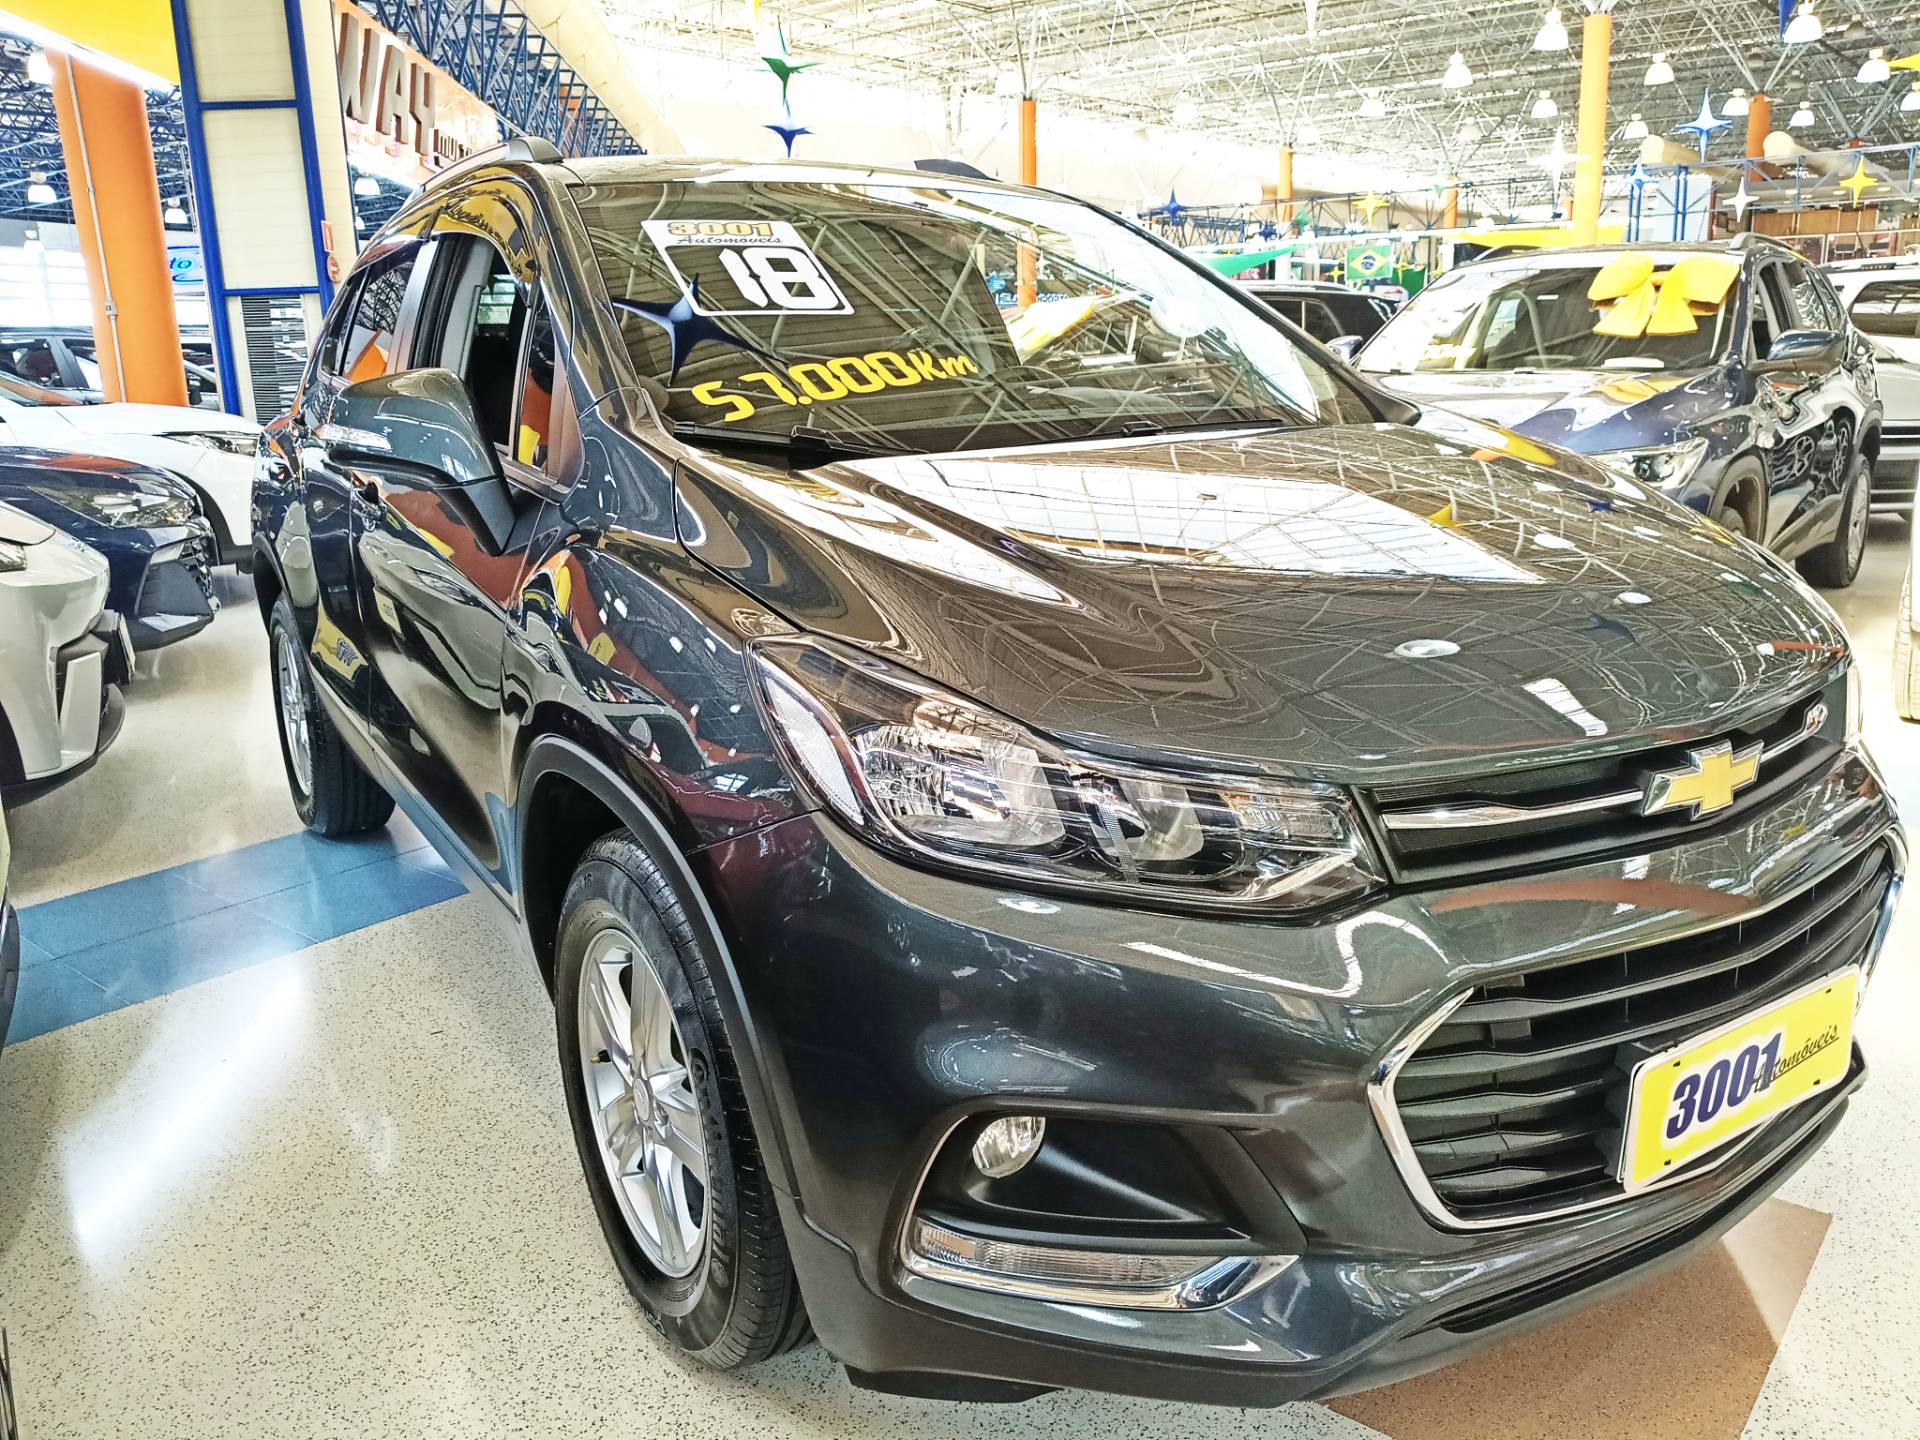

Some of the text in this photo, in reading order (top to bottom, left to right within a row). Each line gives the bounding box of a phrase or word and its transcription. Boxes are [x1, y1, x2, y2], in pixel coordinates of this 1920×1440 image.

[667, 222, 774, 237] 3001
[718, 247, 839, 310] 18
[1666, 1031, 1782, 1140] 3001
